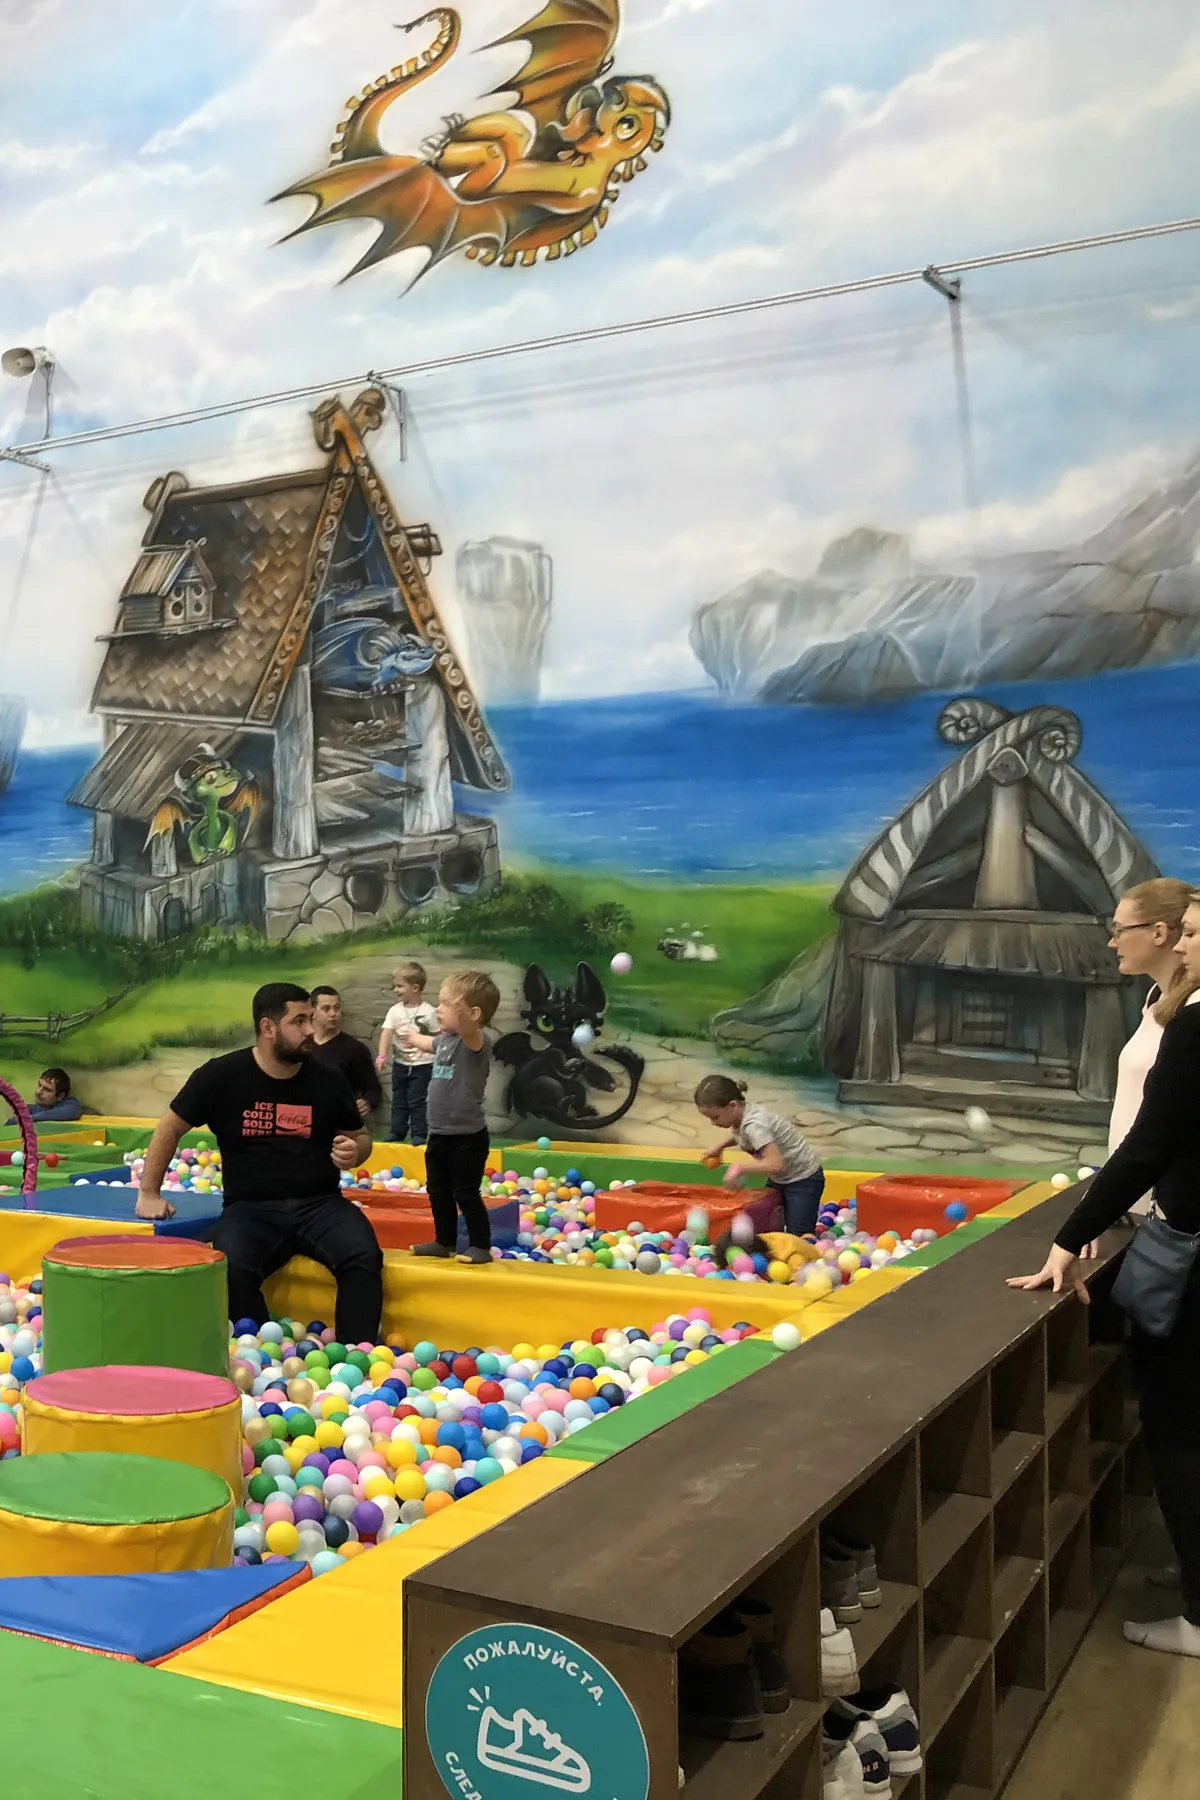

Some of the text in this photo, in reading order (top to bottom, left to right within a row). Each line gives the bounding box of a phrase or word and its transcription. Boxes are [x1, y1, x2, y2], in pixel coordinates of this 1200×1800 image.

[254, 1101, 274, 1111] ICE
[242, 1109, 274, 1120] COLD
[242, 1119, 274, 1129] SOLD
